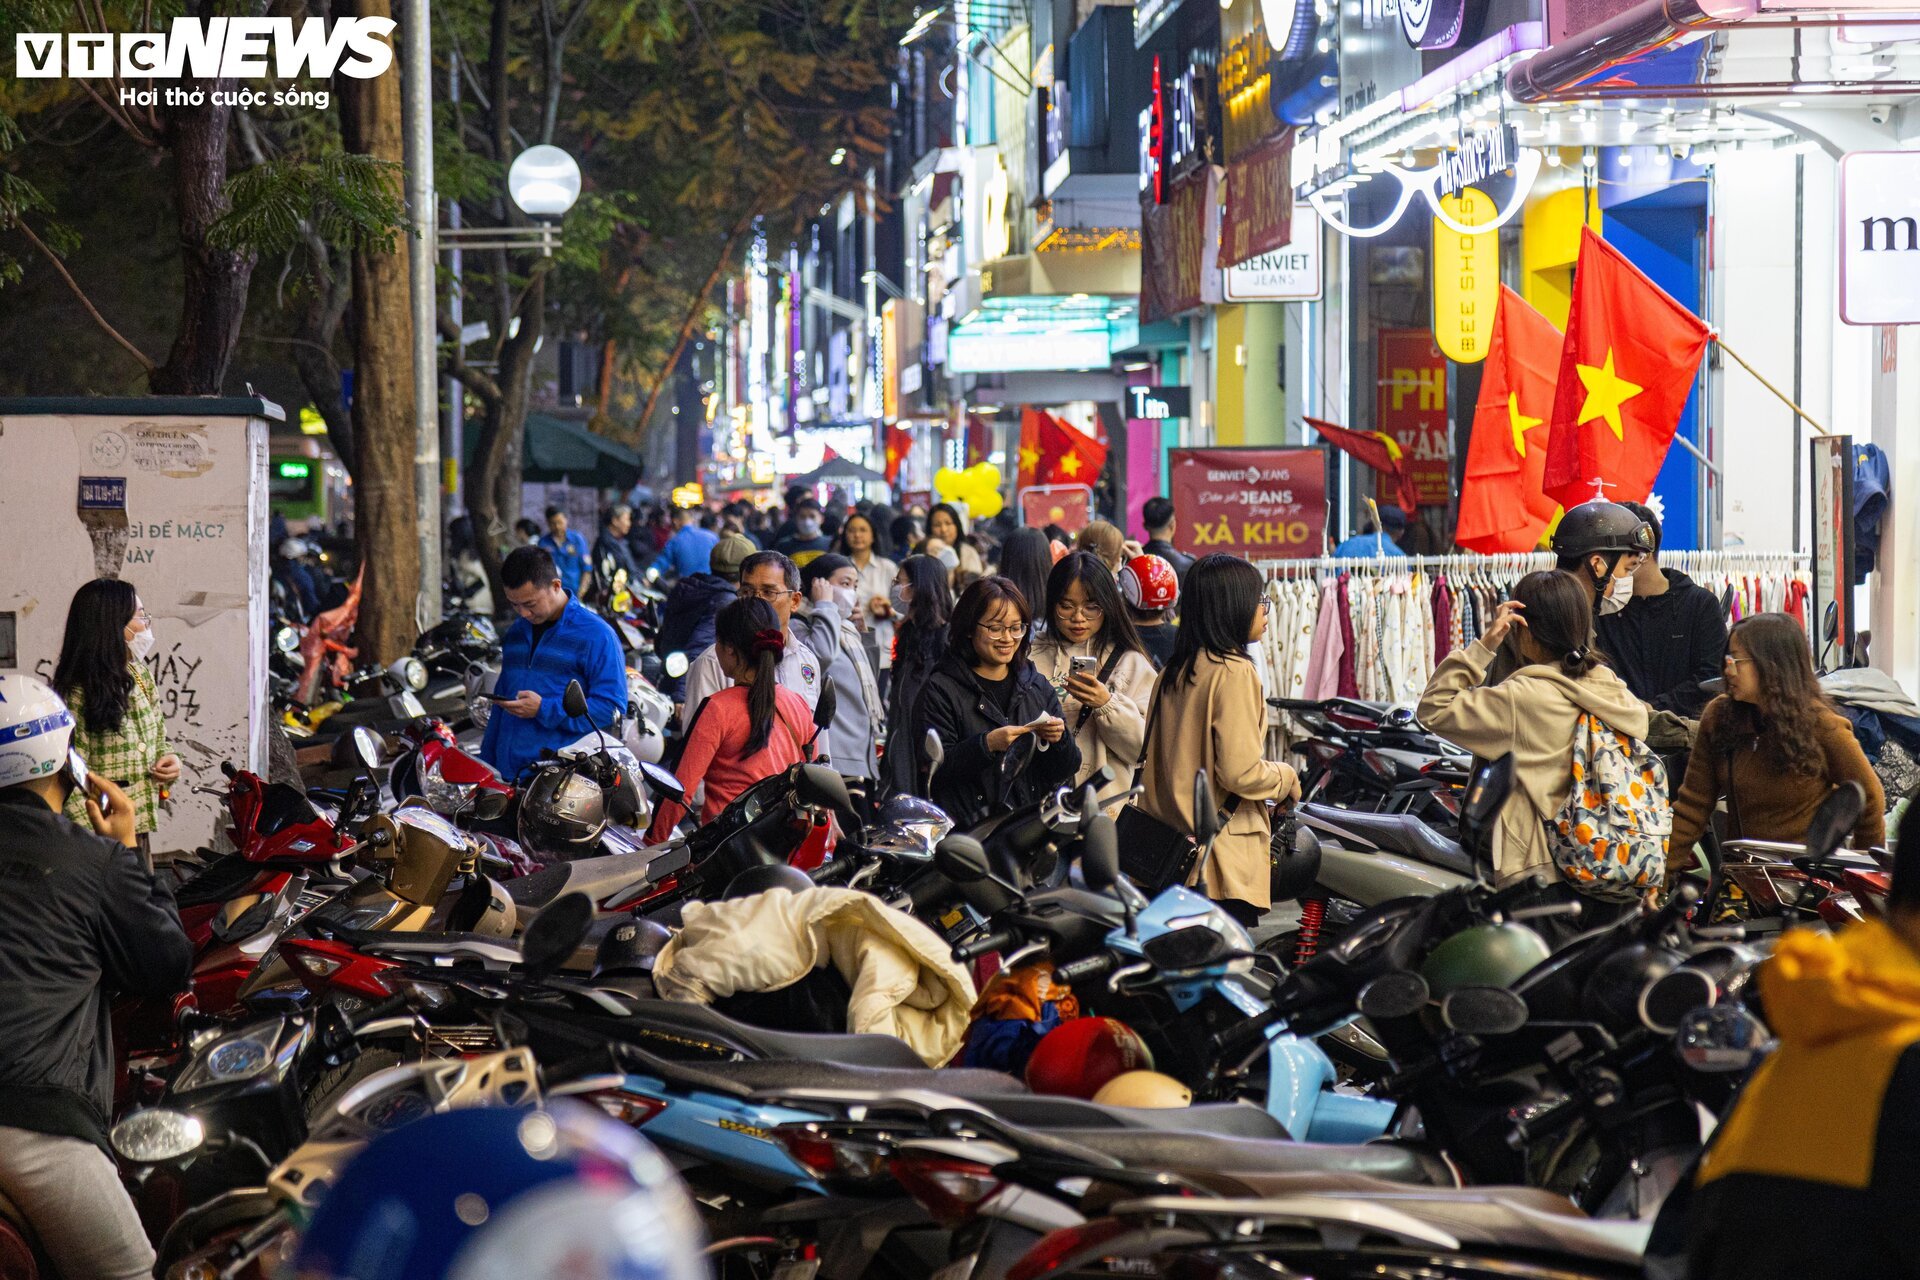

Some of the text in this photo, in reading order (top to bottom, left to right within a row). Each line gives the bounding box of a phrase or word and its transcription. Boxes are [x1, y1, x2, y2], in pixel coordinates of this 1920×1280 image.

[1254, 272, 1295, 286] JEANS
[1460, 301, 1475, 351] BEE
[1261, 469, 1290, 481] JEANS
[1239, 489, 1293, 505] JEANS
[177, 521, 225, 542] MẶC?
[1193, 514, 1310, 545] XẢ KHO
